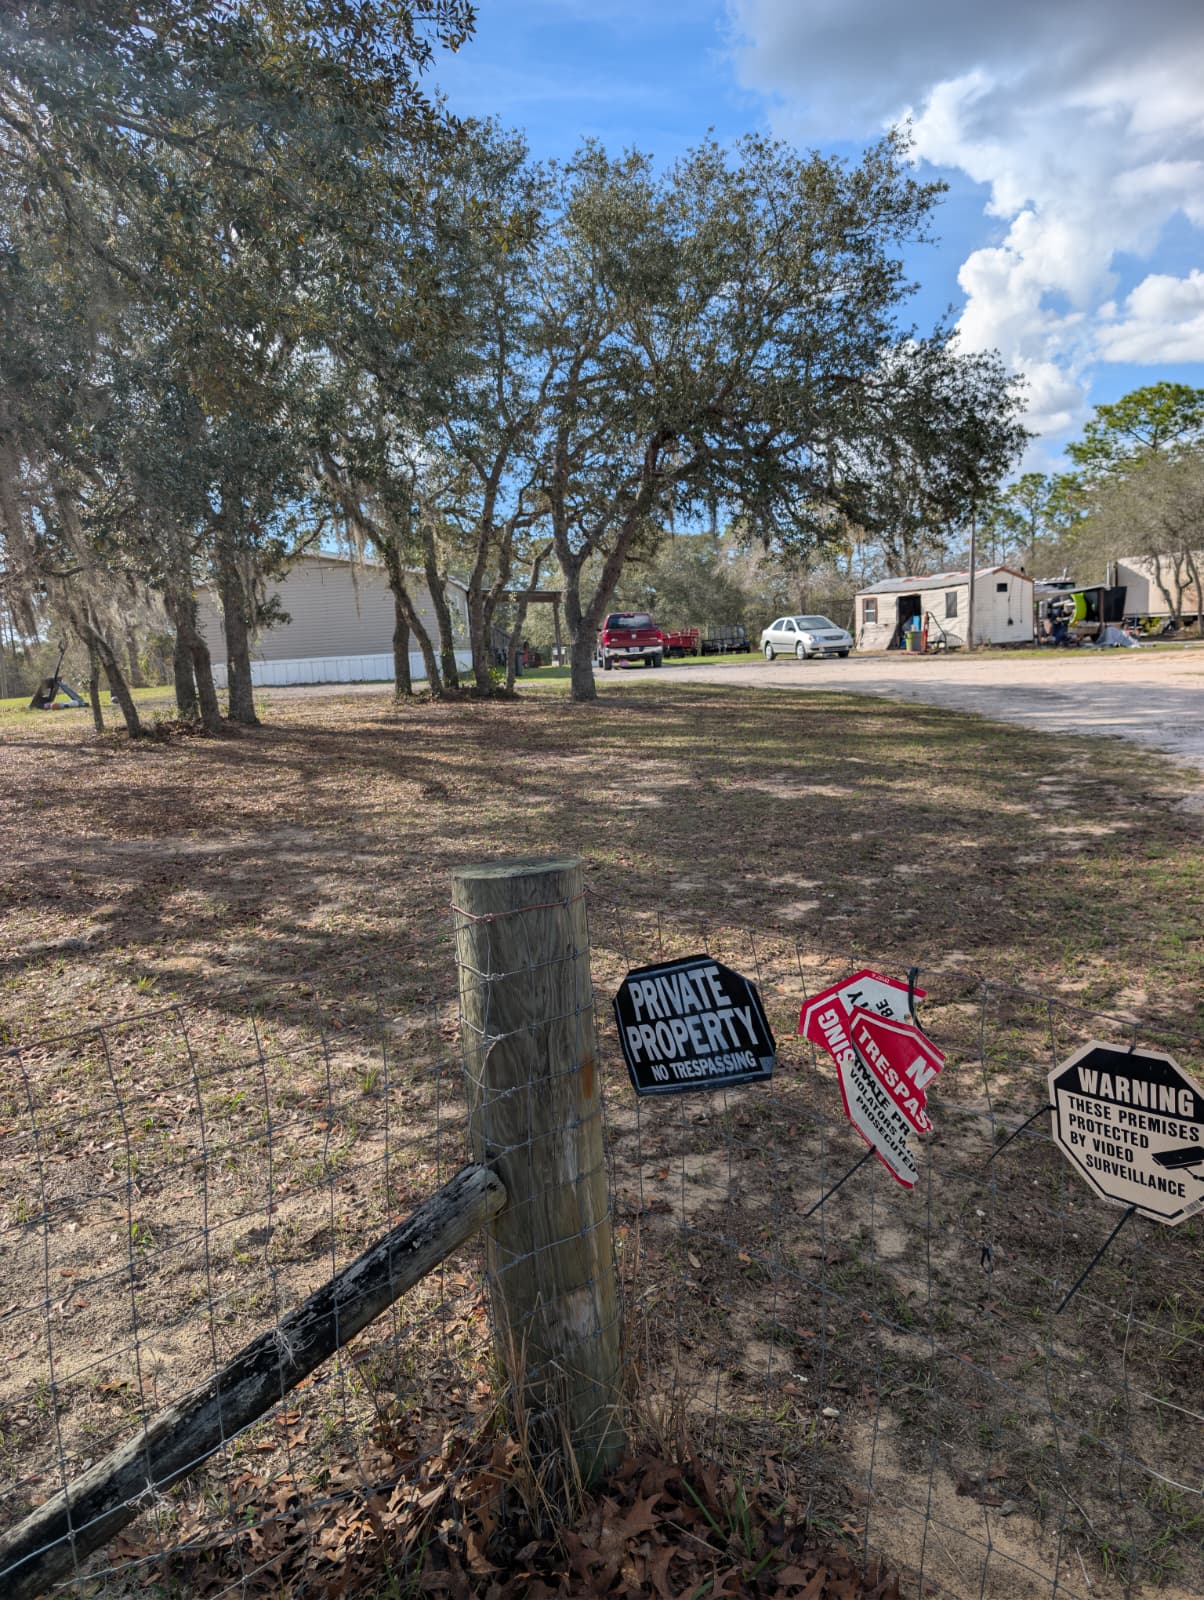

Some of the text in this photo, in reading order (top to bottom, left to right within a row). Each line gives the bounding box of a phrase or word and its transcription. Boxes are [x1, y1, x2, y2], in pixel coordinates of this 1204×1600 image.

[628, 966, 732, 1022] PRIVATE
[876, 998, 894, 1018] BE
[626, 1005, 759, 1063] PROPERTY
[818, 1008, 856, 1065] SING
[651, 1050, 757, 1082] NO TRESPASSING
[858, 1026, 934, 1132] TRESPAS
[905, 1055, 936, 1090] N
[850, 1068, 897, 1135] VIOLATORS
[1077, 1066, 1195, 1118] WARNING
[856, 1096, 916, 1173] PROSECUTED
[891, 1111, 911, 1136] PR
[1068, 1095, 1200, 1142] THESE PREMISES
[1069, 1113, 1149, 1149] PROTECTED
[1070, 1131, 1134, 1163] BY VIDEO
[1086, 1154, 1187, 1198] SURVEILLANCE
